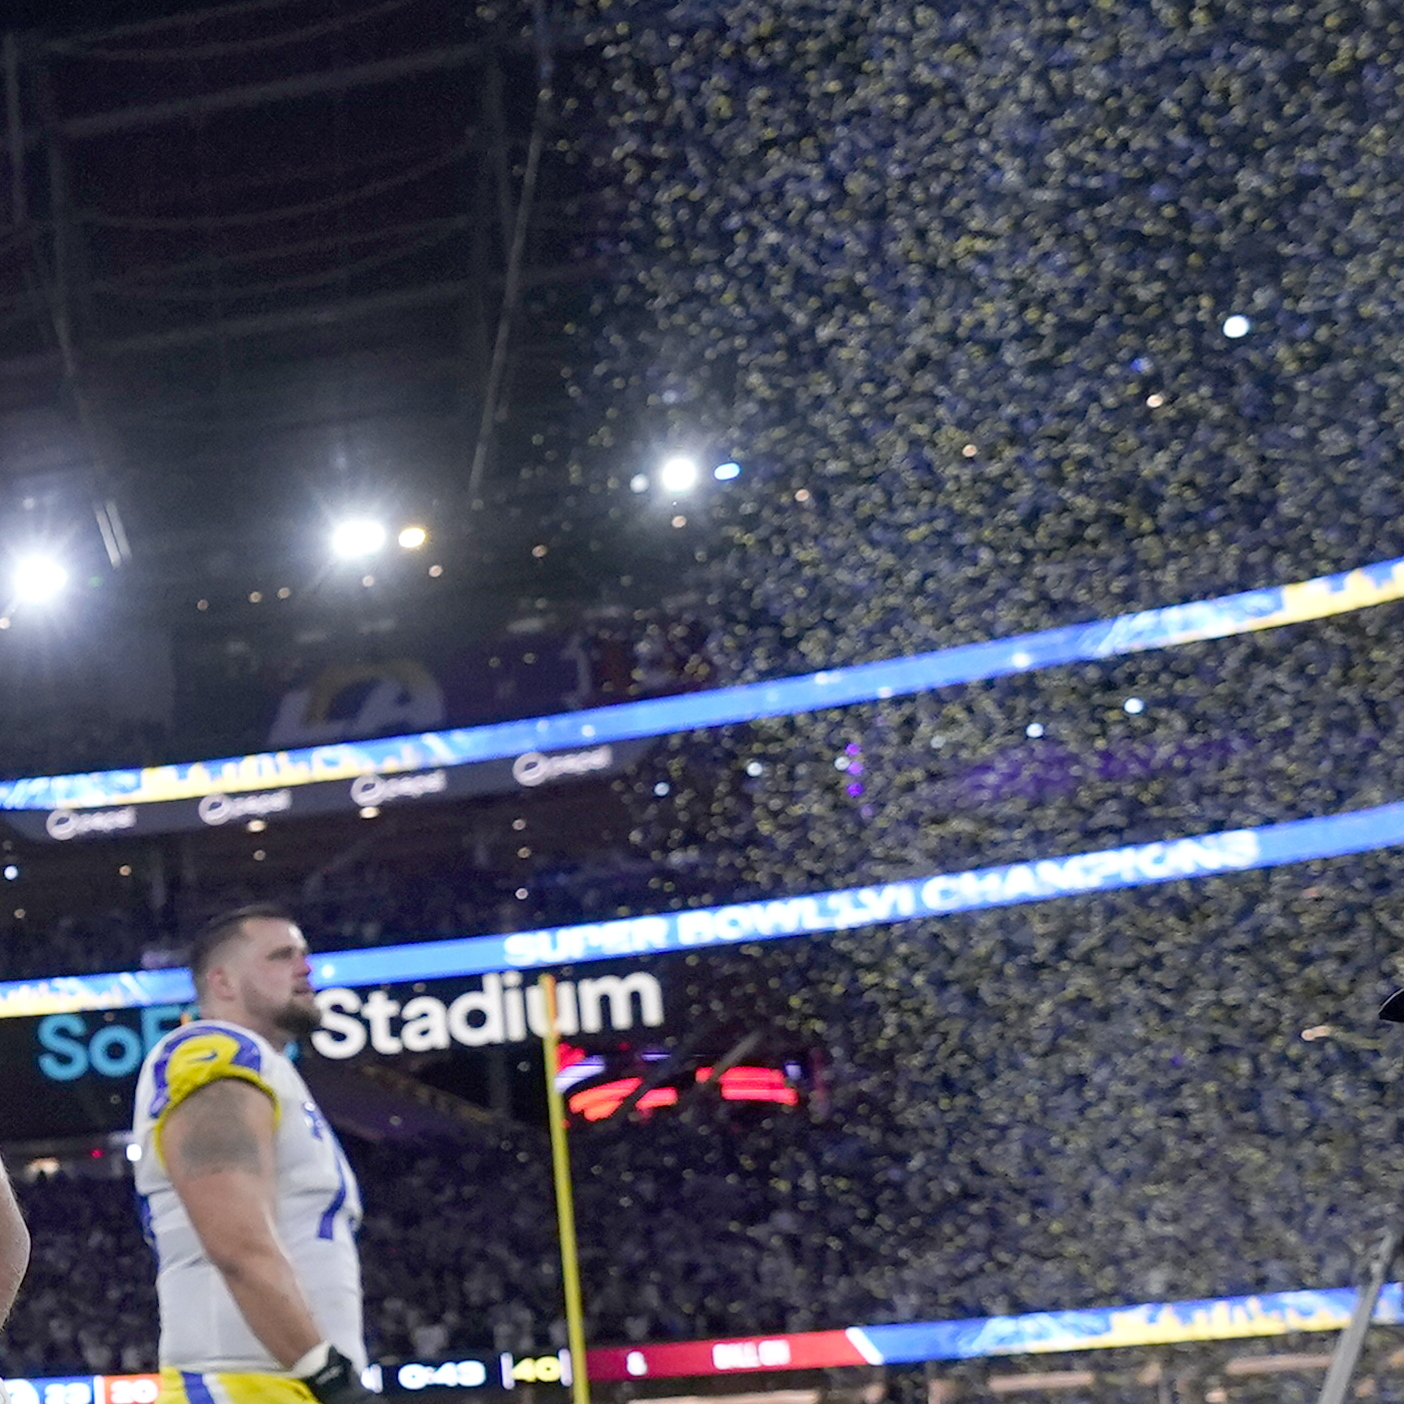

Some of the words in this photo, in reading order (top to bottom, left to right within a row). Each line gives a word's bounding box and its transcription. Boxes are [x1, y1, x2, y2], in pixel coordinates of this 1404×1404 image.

[504, 916, 669, 967] SUPER
[677, 897, 826, 945] BOWL
[921, 830, 1260, 910] CHAMPIONS
[311, 970, 665, 1060] Stadium
